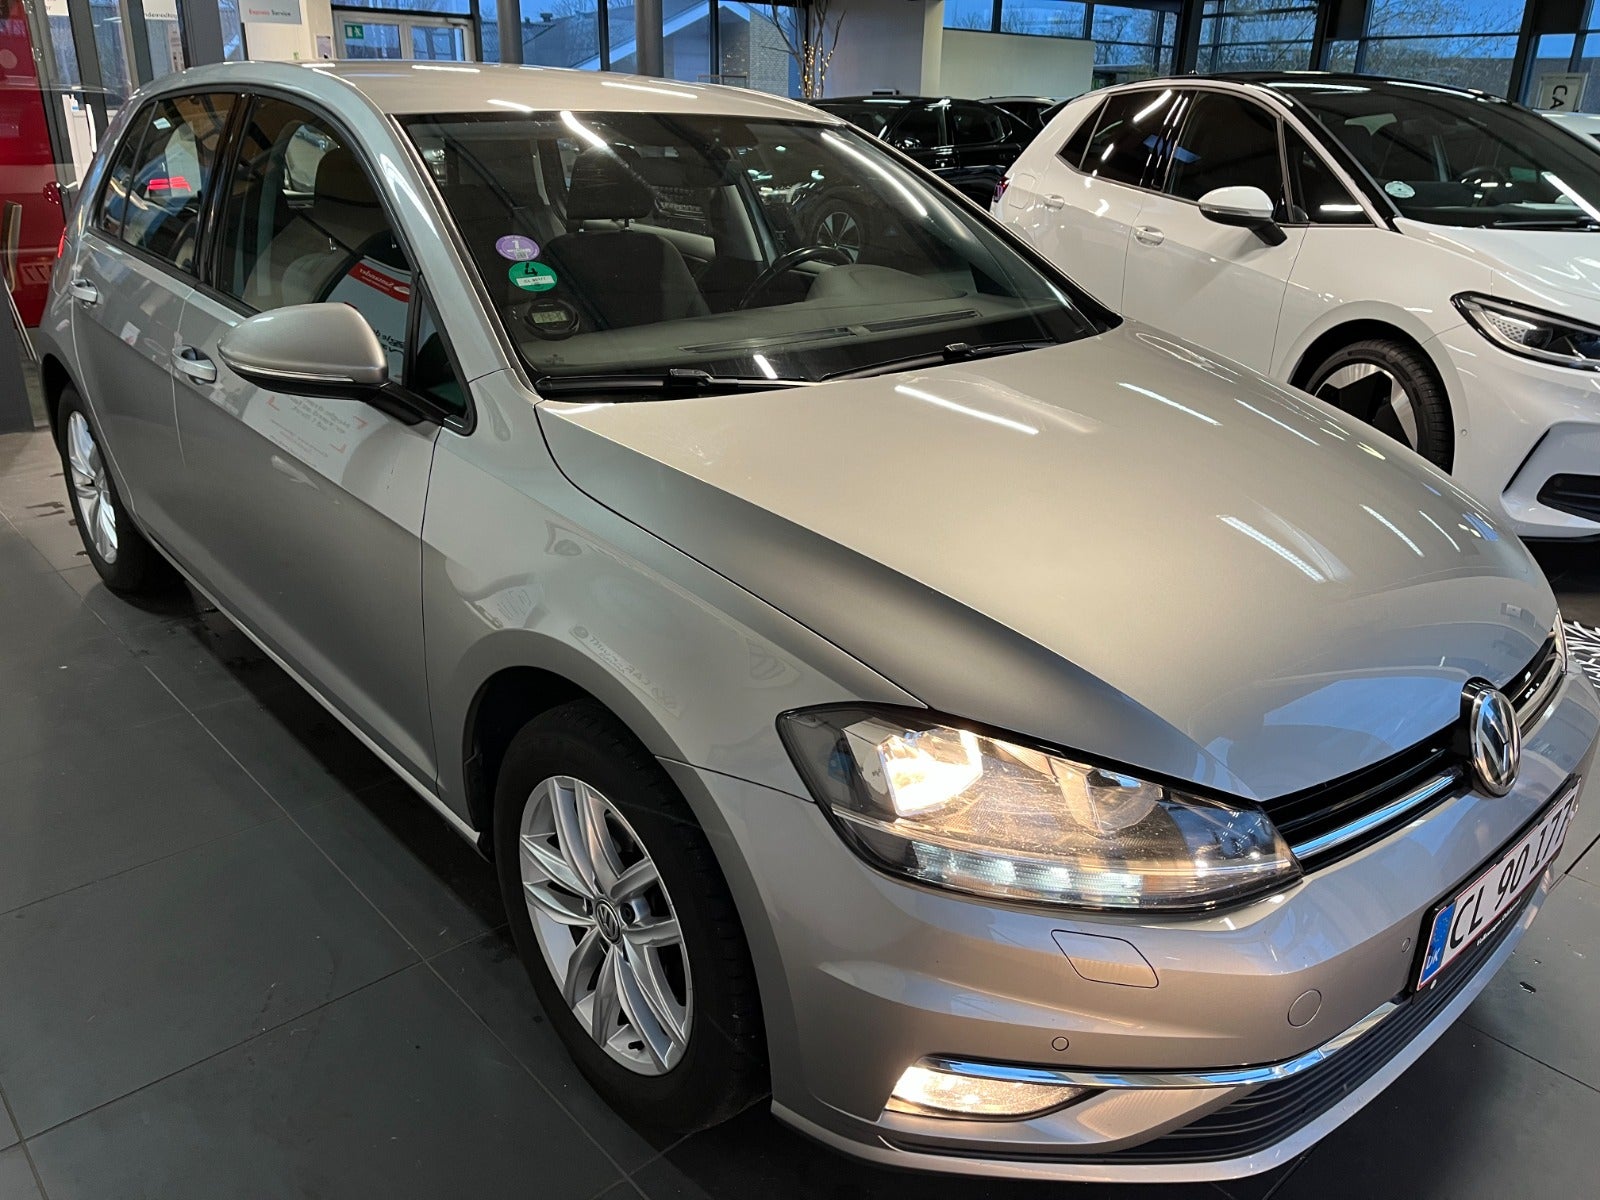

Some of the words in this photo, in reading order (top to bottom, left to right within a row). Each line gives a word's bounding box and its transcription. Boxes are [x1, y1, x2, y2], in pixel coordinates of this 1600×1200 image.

[524, 262, 538, 276] 4
[1450, 885, 1485, 949] CL
[1494, 843, 1530, 911] 90
[1529, 796, 1576, 875] 177
[1425, 948, 1440, 970] DK
